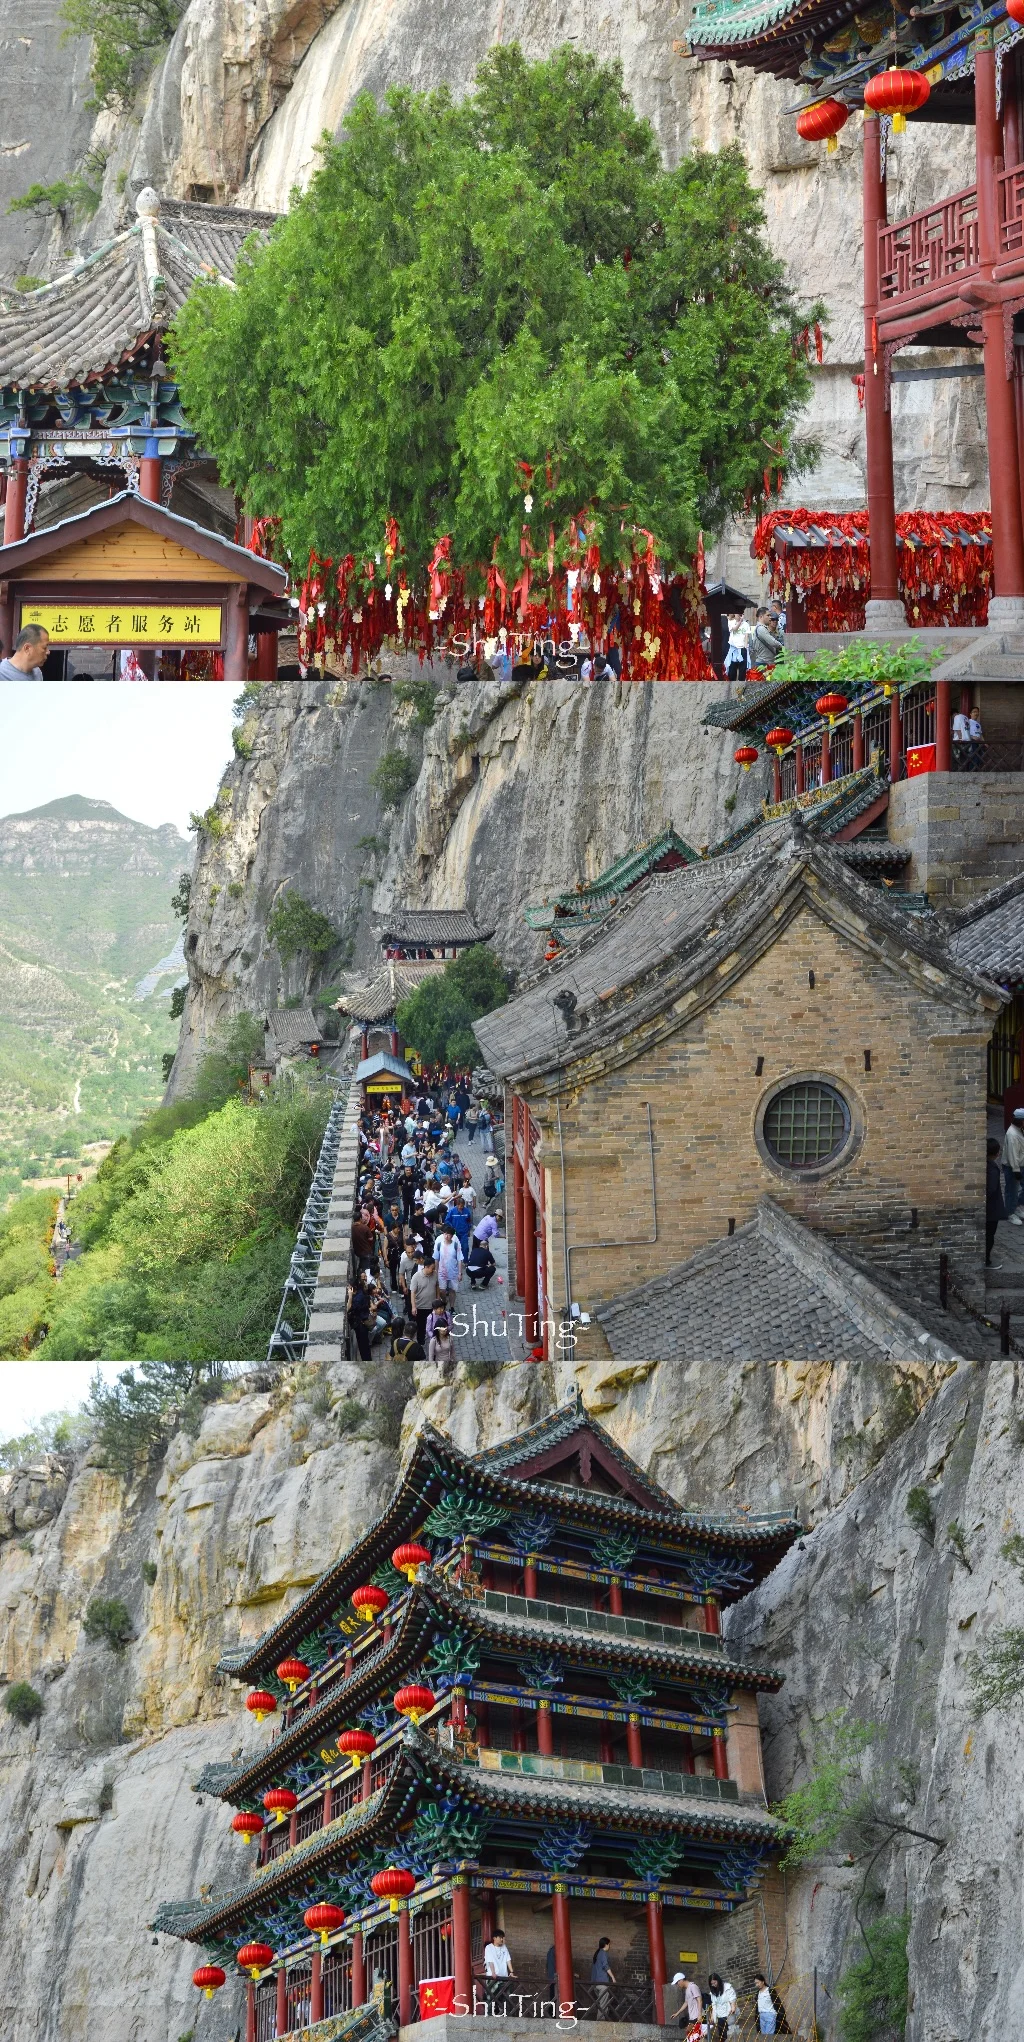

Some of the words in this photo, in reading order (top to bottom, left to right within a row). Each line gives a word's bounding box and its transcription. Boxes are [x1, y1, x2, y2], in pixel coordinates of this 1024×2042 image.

[52, 614, 201, 633] 志愿者服务站
